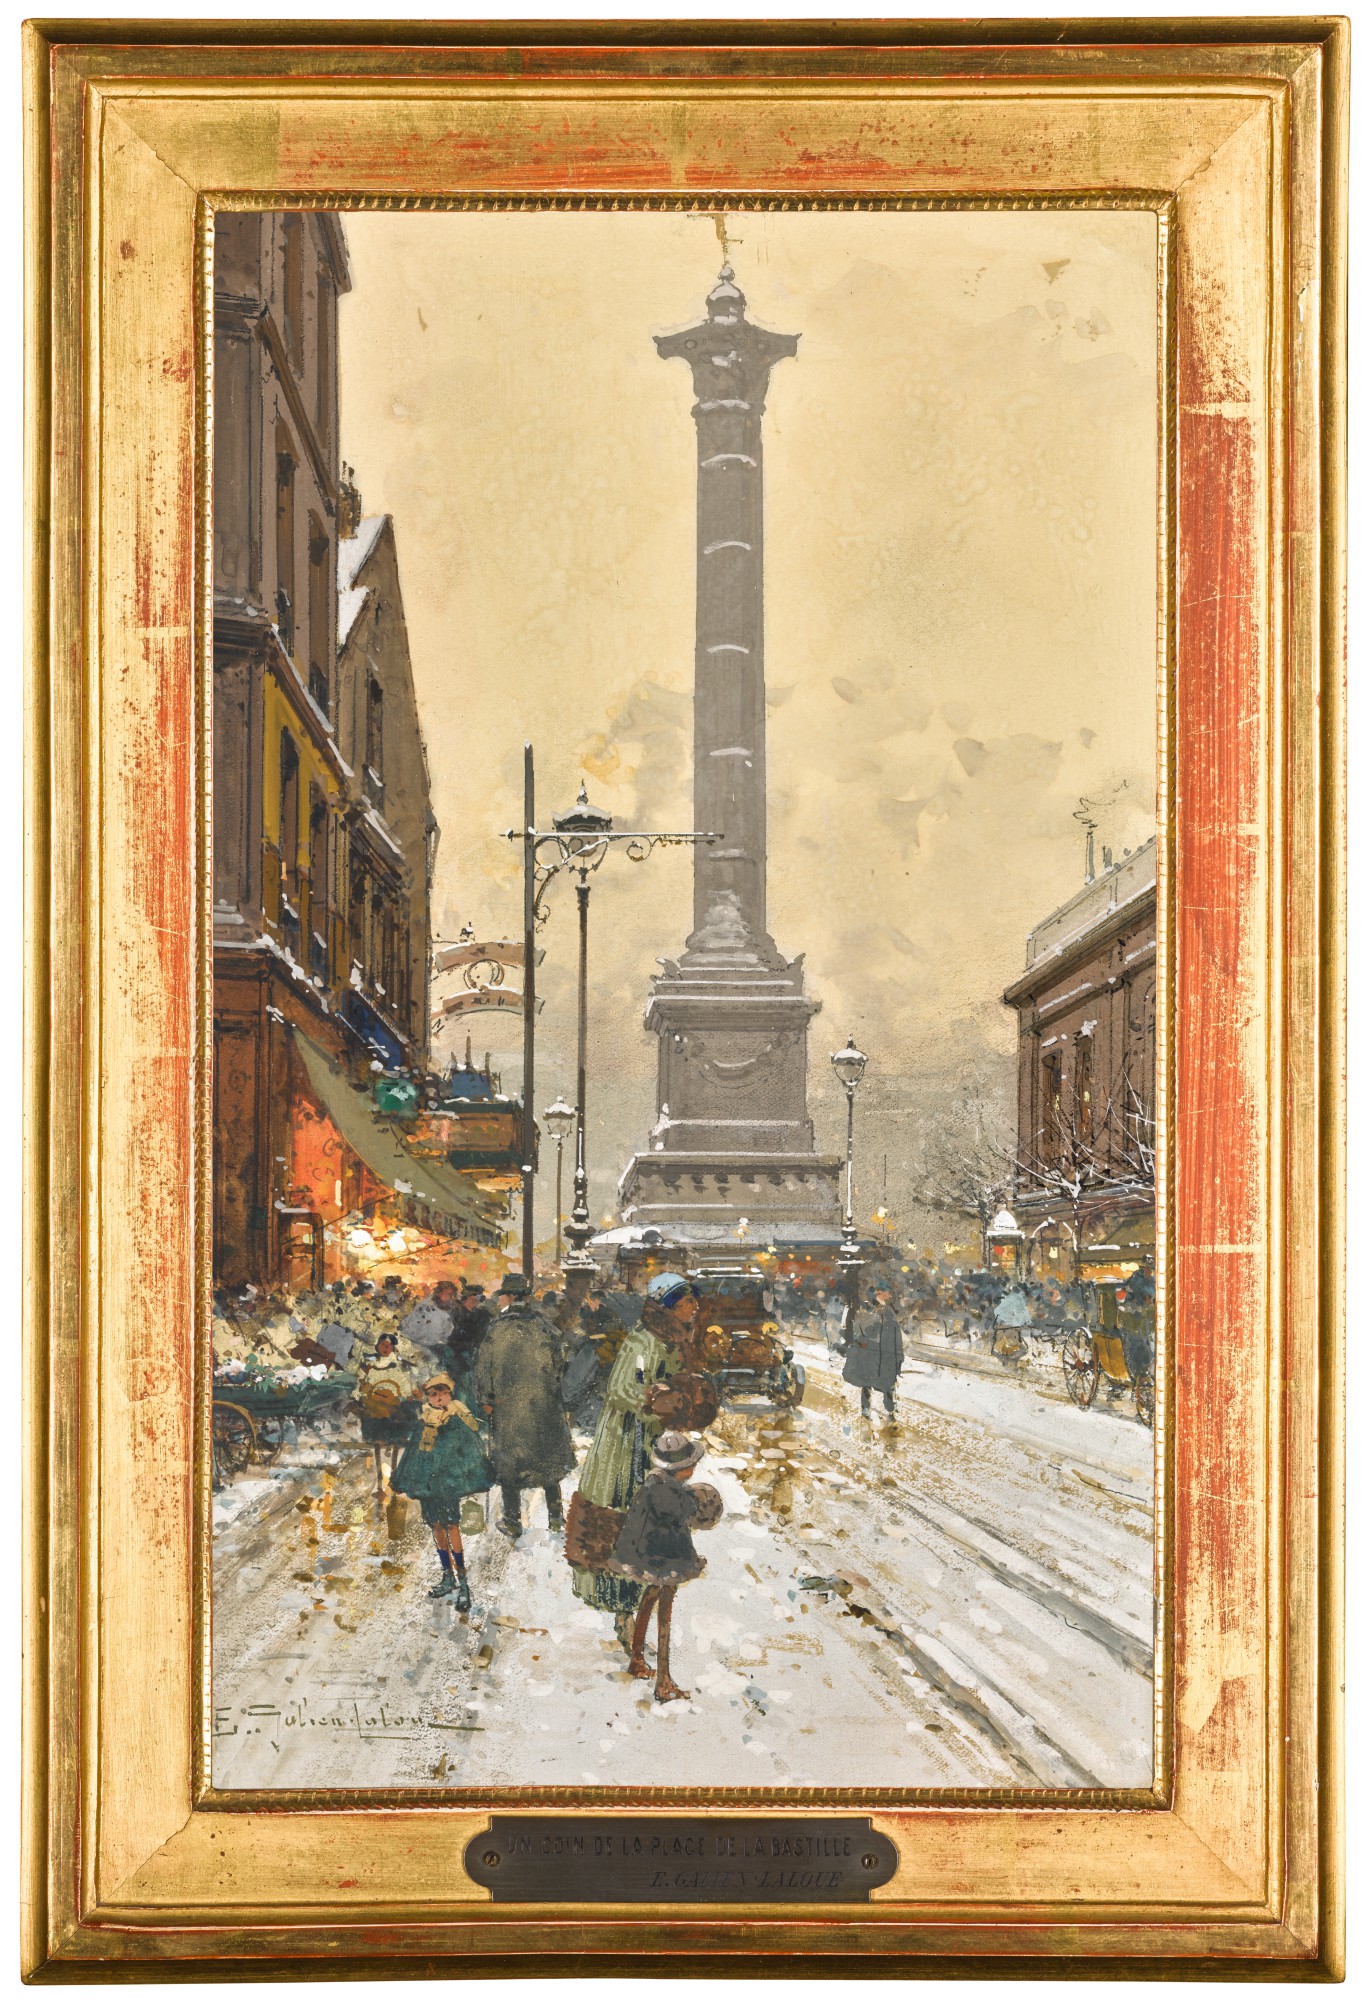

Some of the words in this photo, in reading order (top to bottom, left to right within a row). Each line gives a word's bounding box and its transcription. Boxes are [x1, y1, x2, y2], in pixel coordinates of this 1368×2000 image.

[507, 1836, 532, 1855] UN
[541, 1836, 585, 1856] COIN
[594, 1836, 614, 1856] DE
[622, 1836, 644, 1856] LA
[651, 1836, 705, 1856] PLACE
[715, 1836, 736, 1856] DE
[743, 1836, 765, 1857] LA
[770, 1836, 851, 1857] BASTILLE
